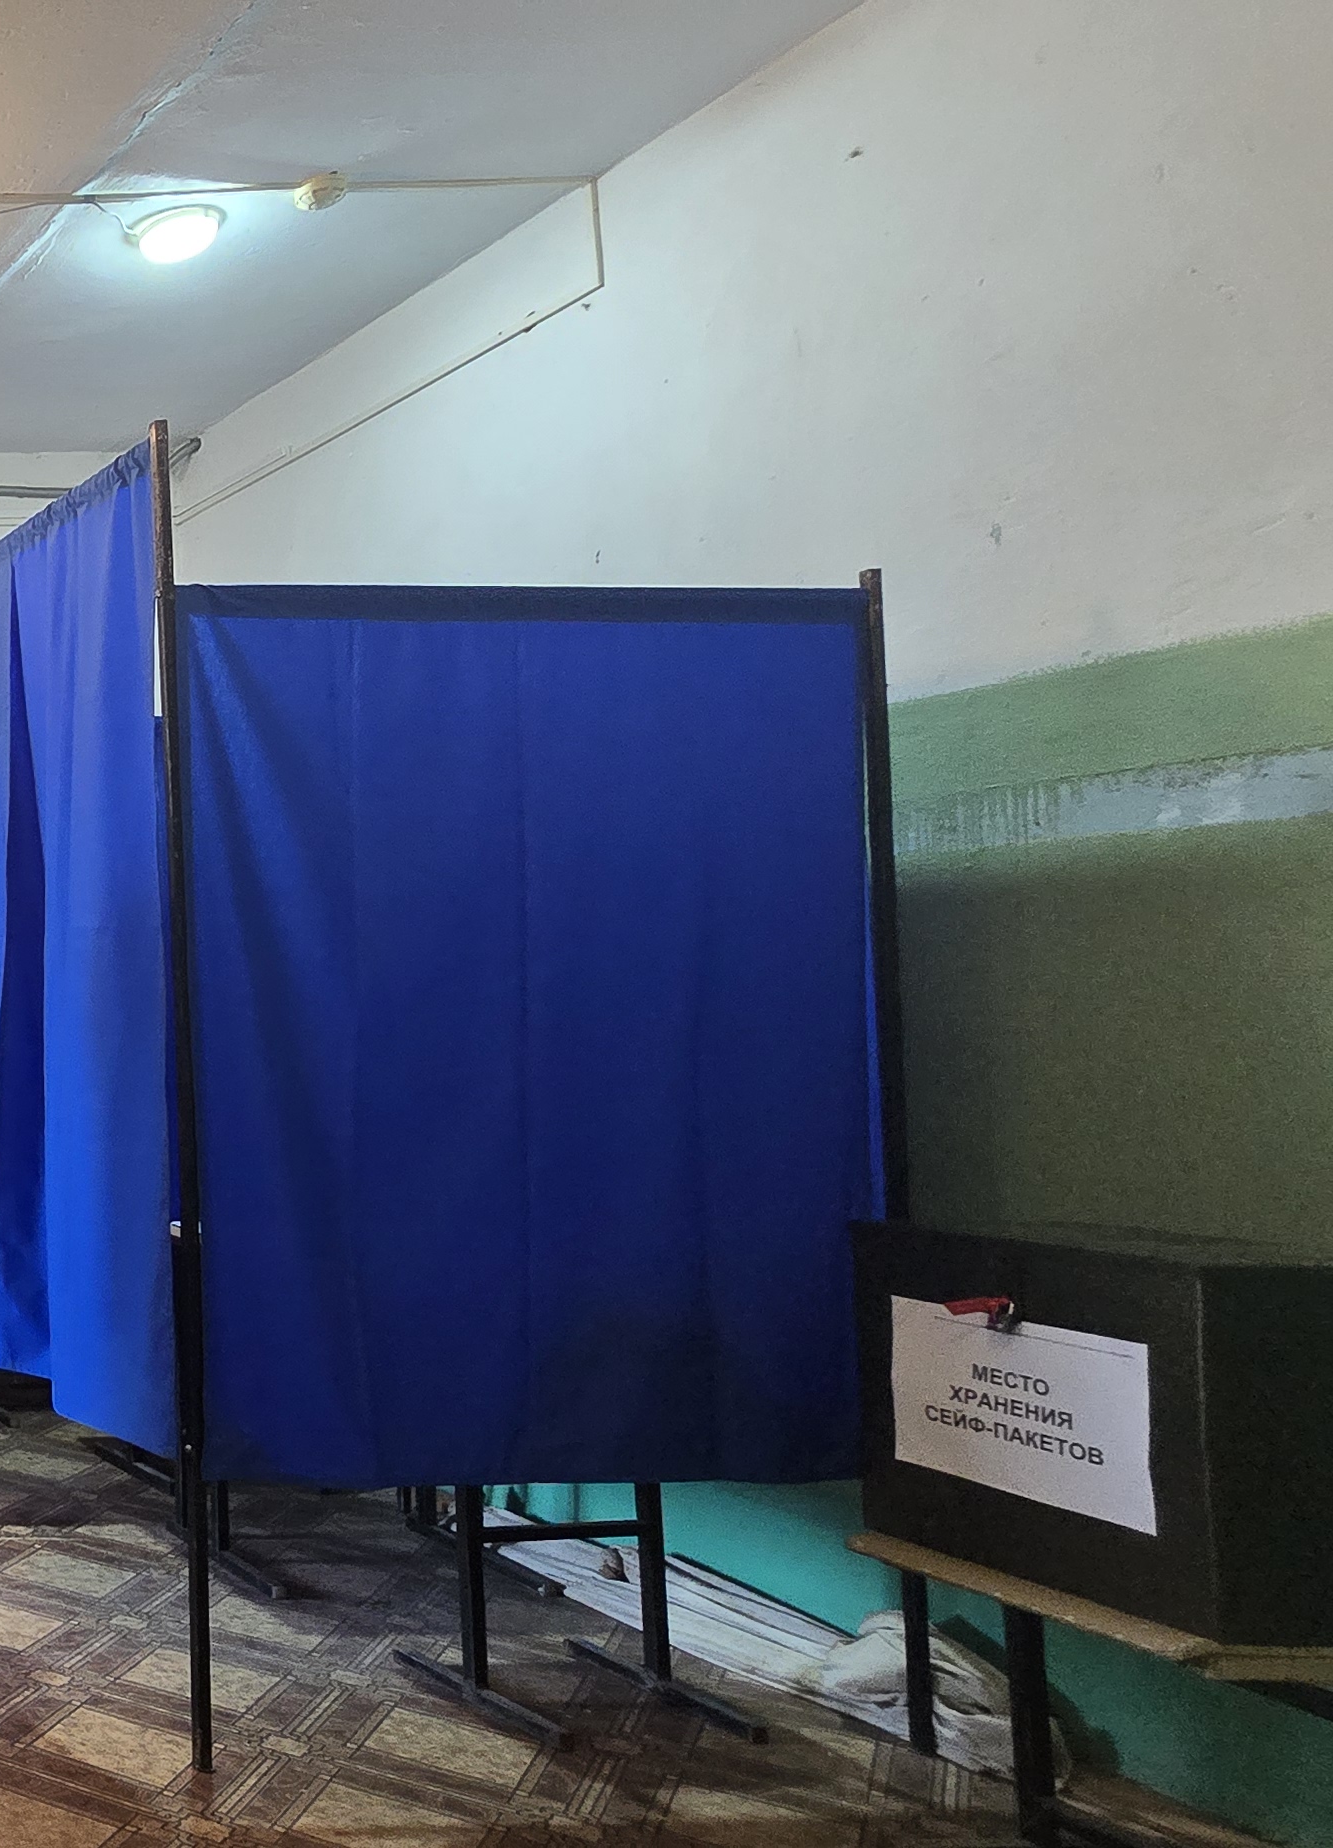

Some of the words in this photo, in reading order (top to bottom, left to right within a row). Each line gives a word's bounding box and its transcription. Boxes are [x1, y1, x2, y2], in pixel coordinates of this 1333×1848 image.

[971, 1363, 1050, 1396] МЕСТО
[949, 1384, 1073, 1430] ХРАНЕНИЯ
[924, 1404, 1105, 1466] СЕЙФ-ПАКЕТОВ
